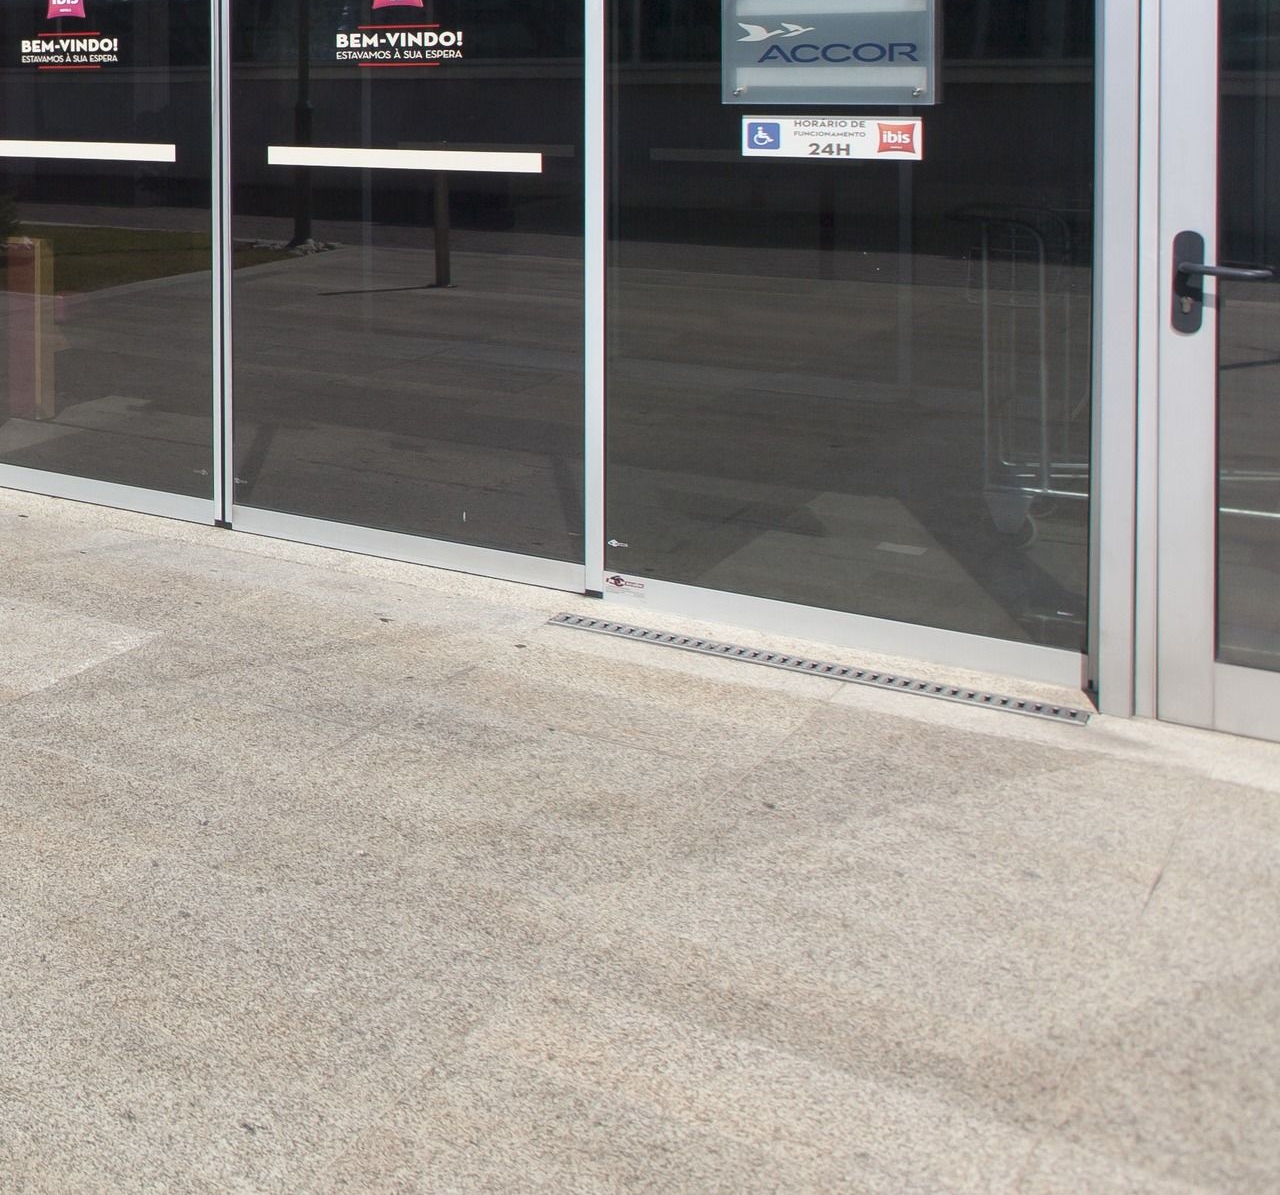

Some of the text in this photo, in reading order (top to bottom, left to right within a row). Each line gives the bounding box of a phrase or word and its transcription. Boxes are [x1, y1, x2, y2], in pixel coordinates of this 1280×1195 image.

[21, 38, 118, 53] BEM-VINDO!
[336, 31, 463, 48] BEM-VINDO!
[21, 52, 118, 63] ESTAVAMOS À SUA ESPERA
[336, 48, 463, 60] ESTAVAMOS À SUA ESPERA
[757, 42, 919, 64] ACCOR
[794, 118, 865, 128] HORÁRIO DE
[882, 130, 911, 144] ibis
[808, 143, 850, 156] 24H
